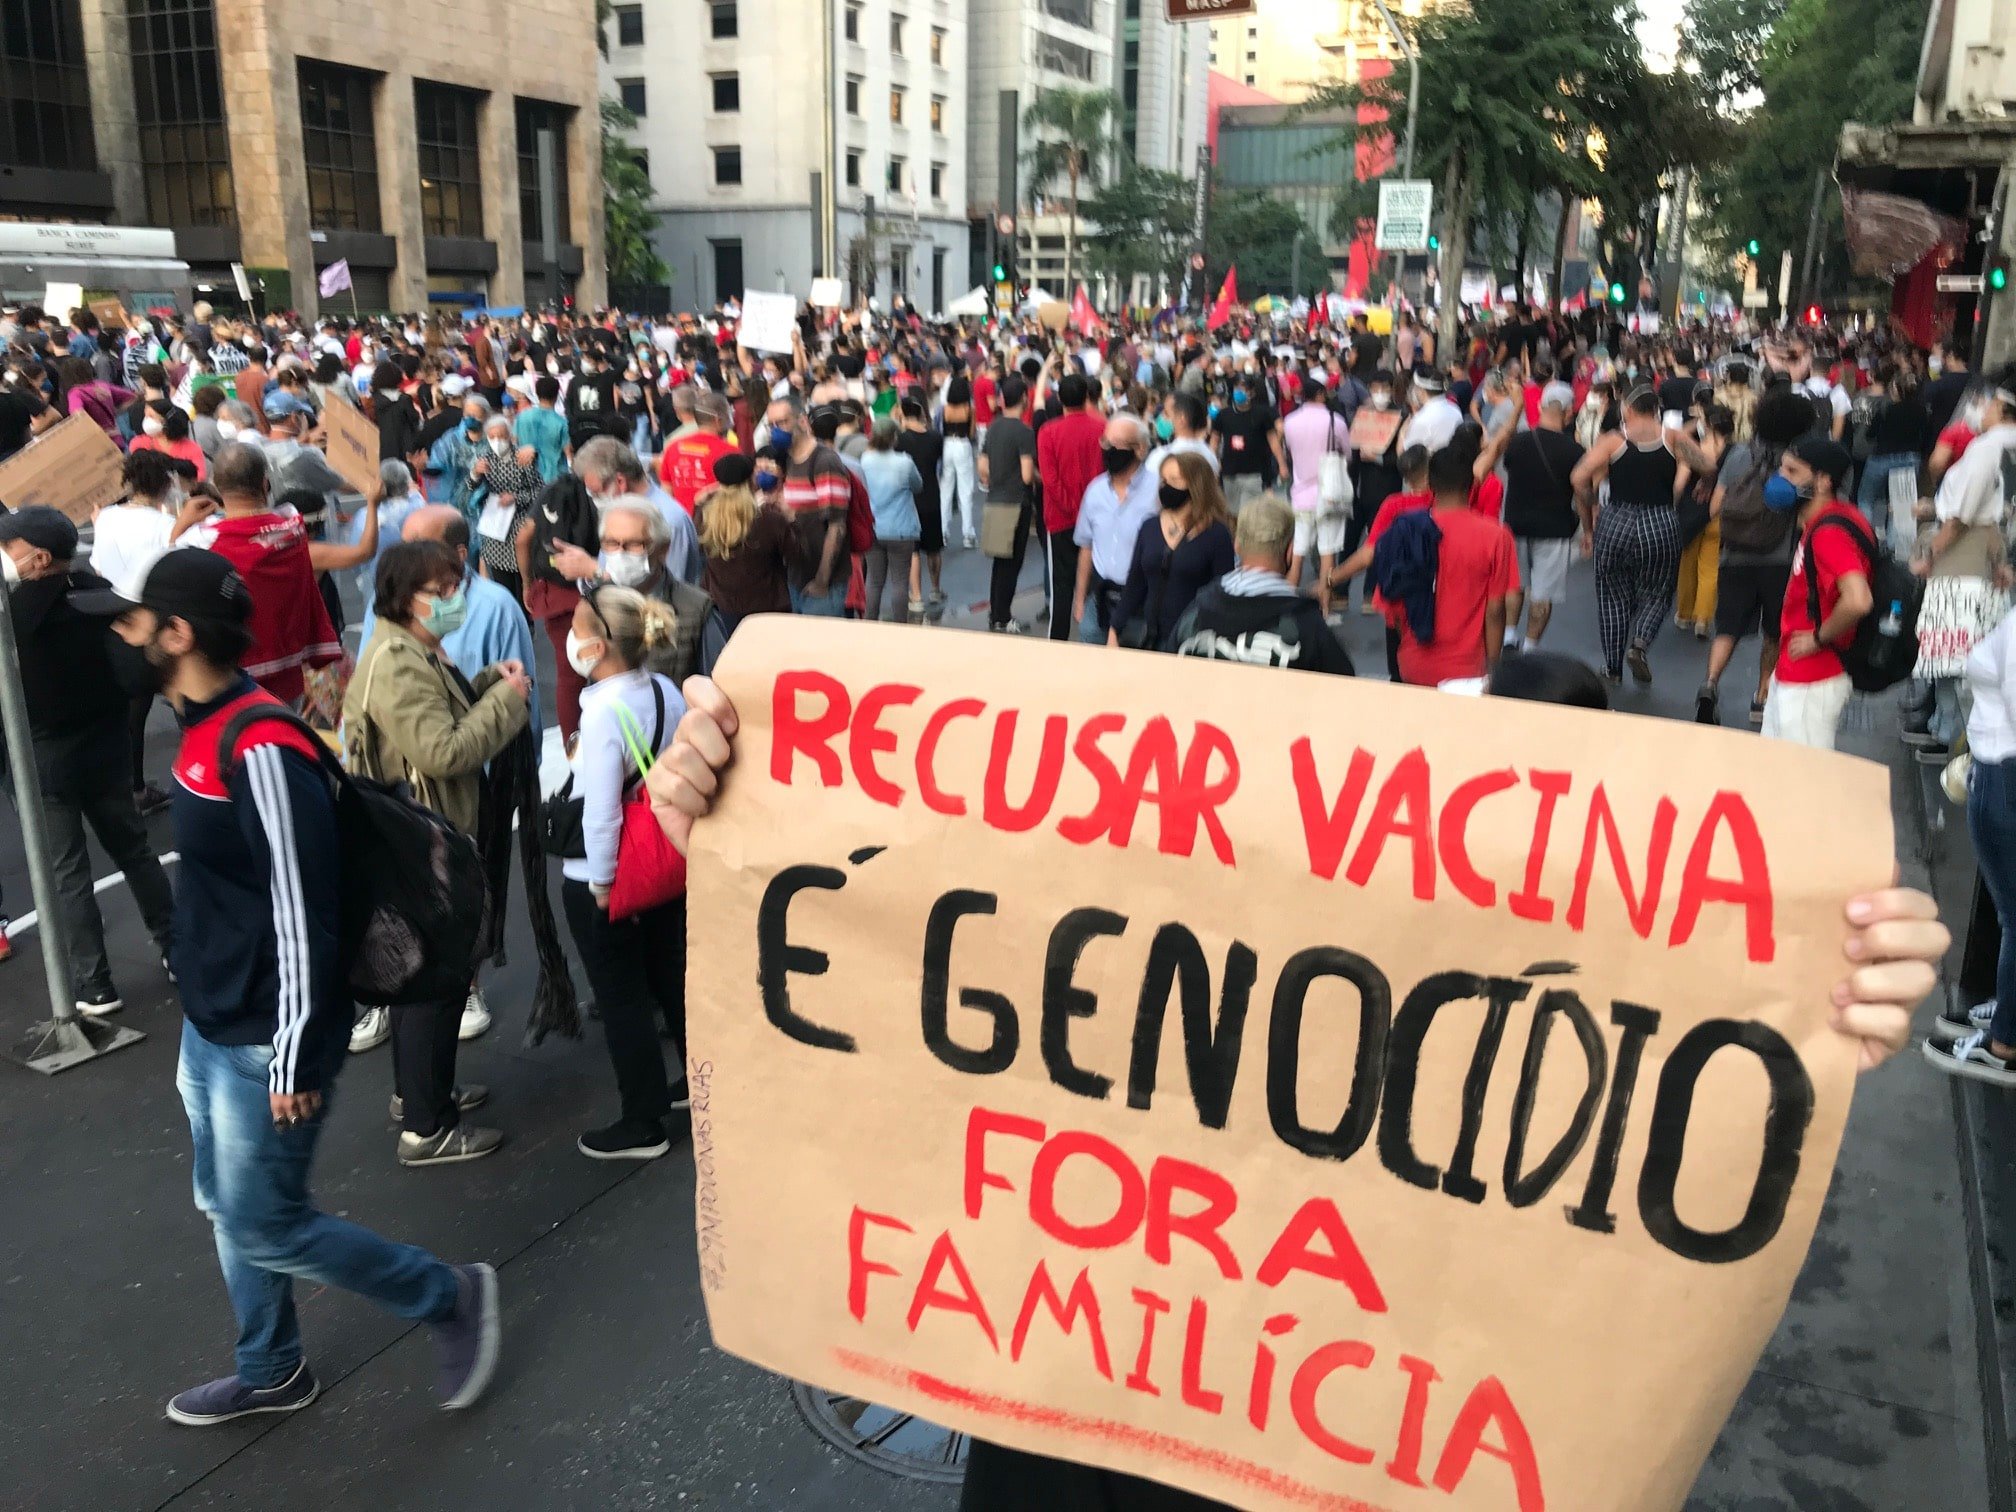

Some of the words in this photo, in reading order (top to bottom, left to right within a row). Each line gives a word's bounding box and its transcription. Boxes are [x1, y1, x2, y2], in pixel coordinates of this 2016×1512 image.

[769, 669, 1241, 868] RECUSAR
[1289, 734, 1776, 963] VACINA
[757, 845, 889, 1053] É
[921, 889, 1816, 1264] GENOCÍDIO
[848, 1203, 1547, 1512] FAMILÍCIA
[963, 1106, 1389, 1314] FORA
